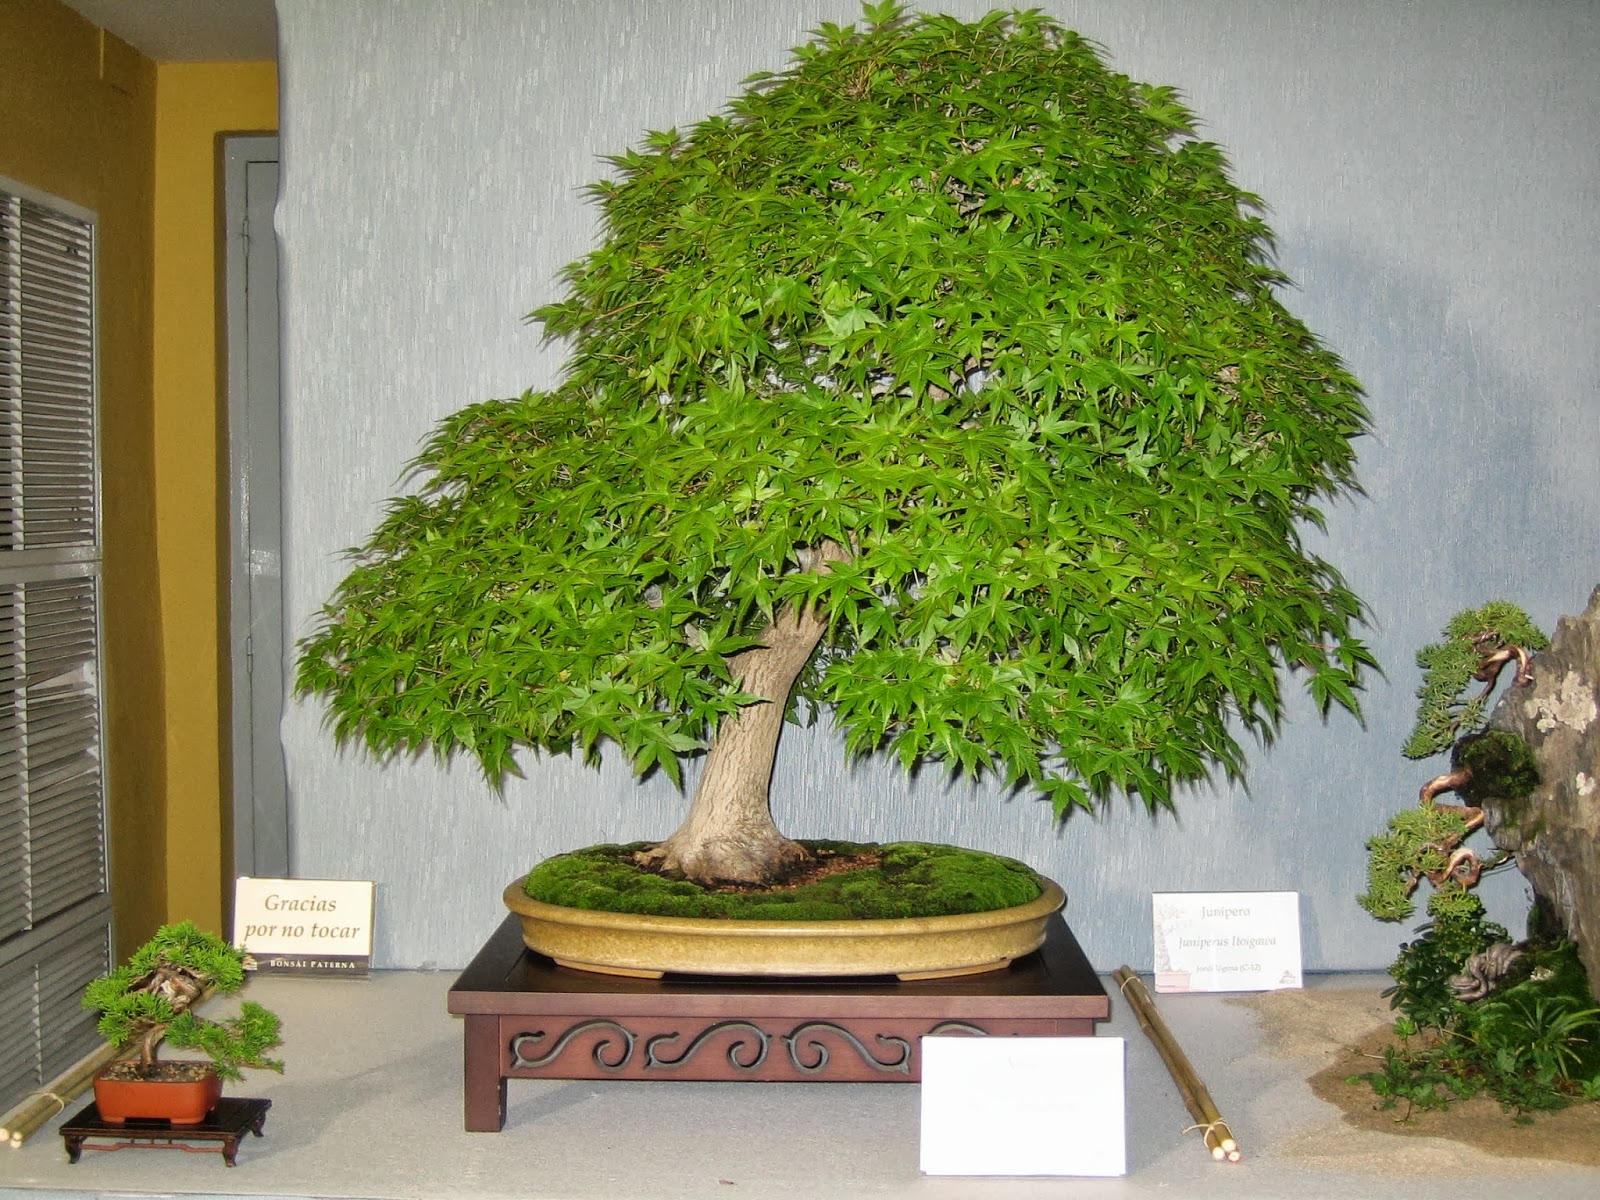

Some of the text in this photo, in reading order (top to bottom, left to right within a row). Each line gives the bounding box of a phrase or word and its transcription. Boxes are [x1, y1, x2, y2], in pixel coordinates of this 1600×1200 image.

[264, 894, 337, 912] Gracias
[244, 923, 361, 941] por no tocar
[310, 961, 356, 969] PATERNA
